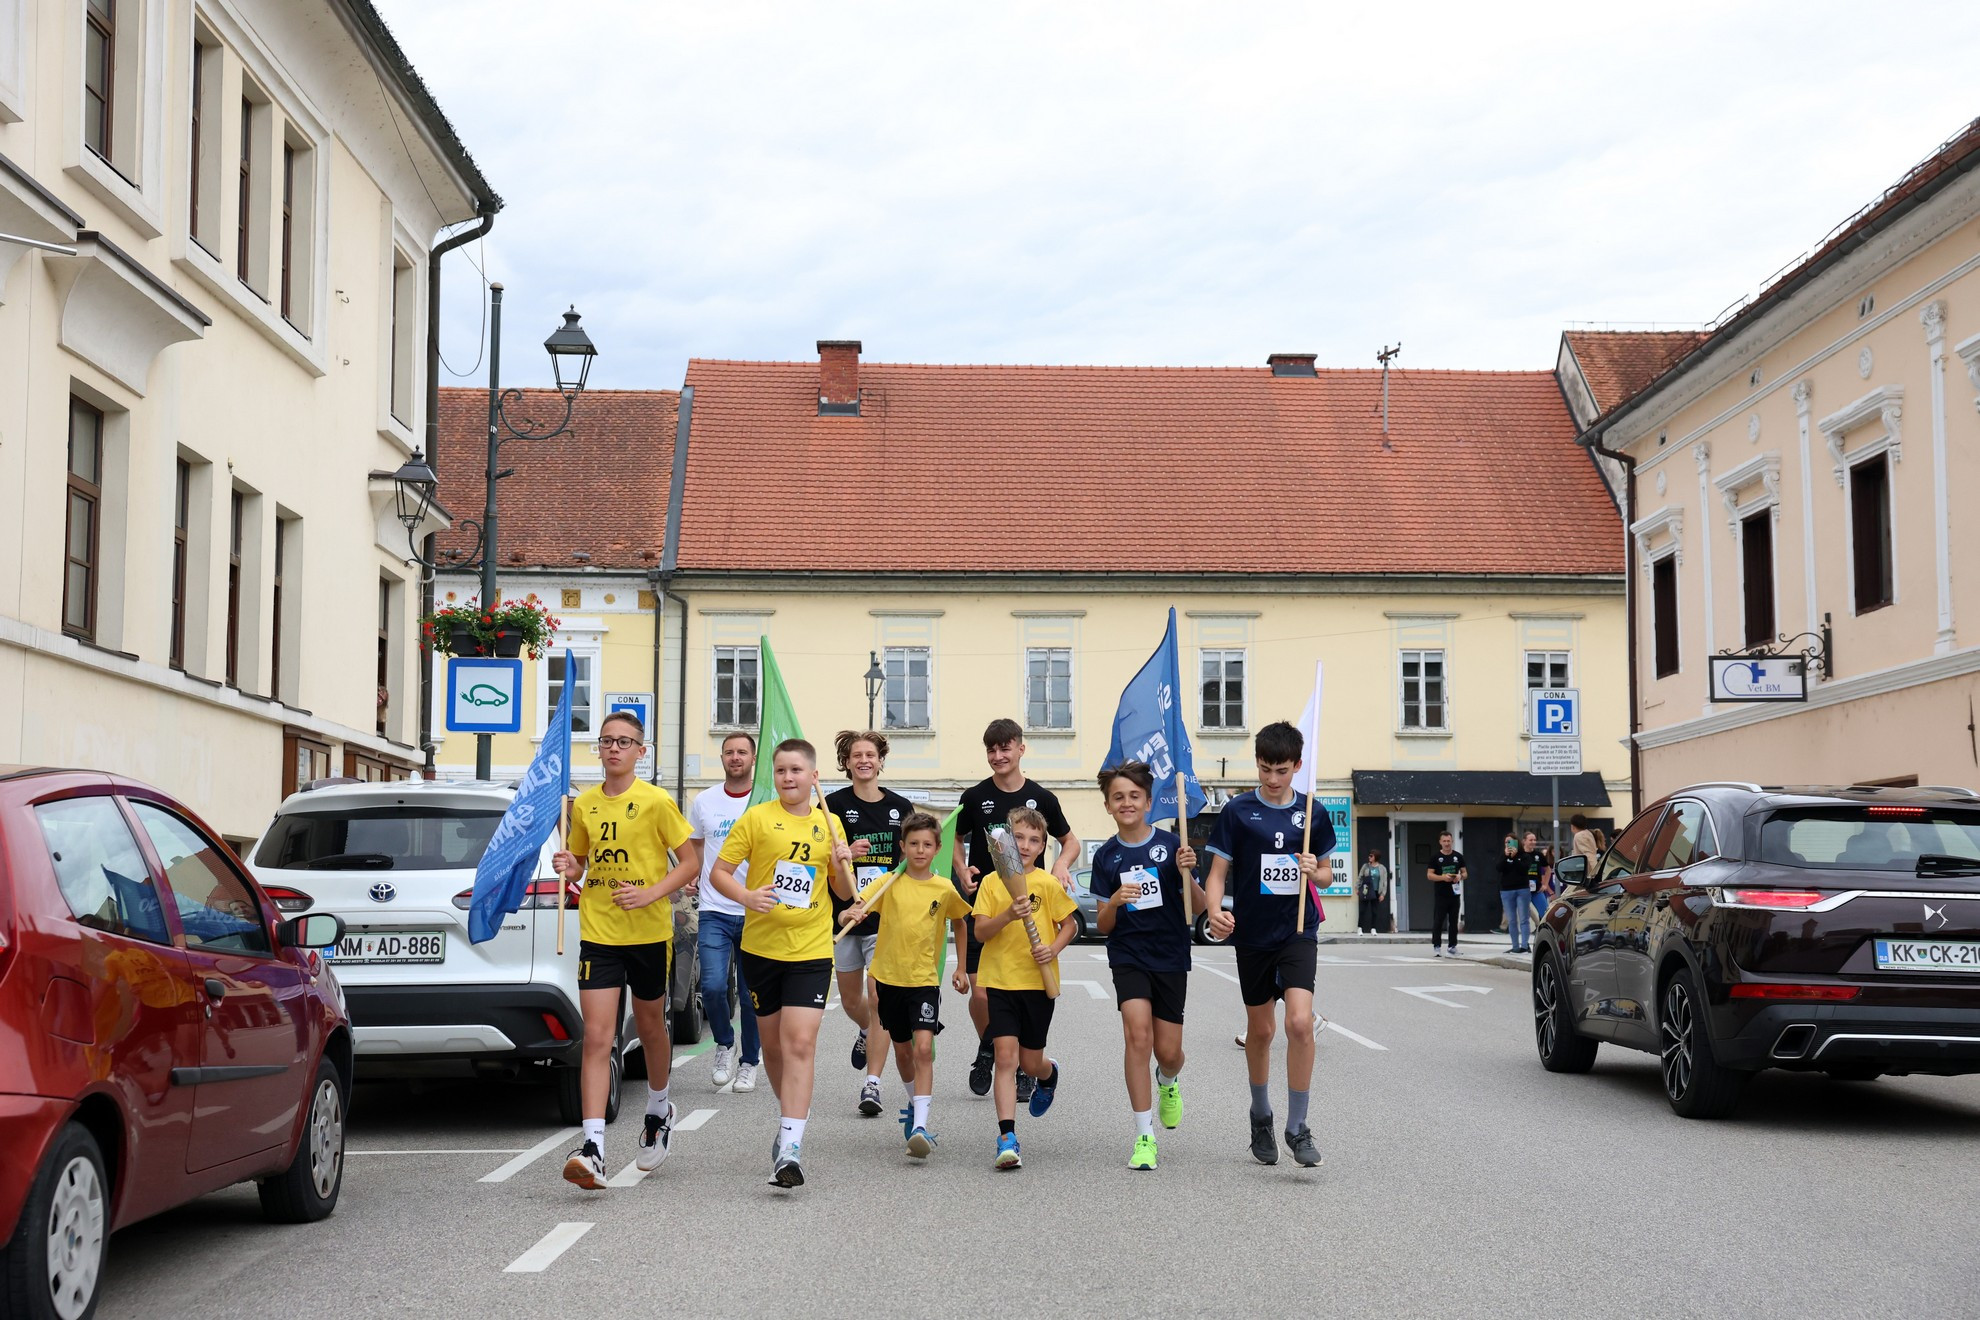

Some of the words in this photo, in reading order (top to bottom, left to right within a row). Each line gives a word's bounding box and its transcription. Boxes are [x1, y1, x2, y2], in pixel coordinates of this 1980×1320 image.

[1747, 684, 1763, 692] Vet
[1765, 684, 1781, 692] BM
[1545, 704, 1564, 729] P
[600, 822, 616, 840] 21
[867, 843, 893, 855] DELEK
[1274, 832, 1284, 849] 3
[788, 841, 811, 862] 73
[774, 874, 811, 894] 8284
[1263, 868, 1298, 882] 8283
[1141, 881, 1158, 895] 85
[335, 938, 362, 956] NM
[376, 936, 441, 956] AD-886
[1892, 944, 1916, 962] KK
